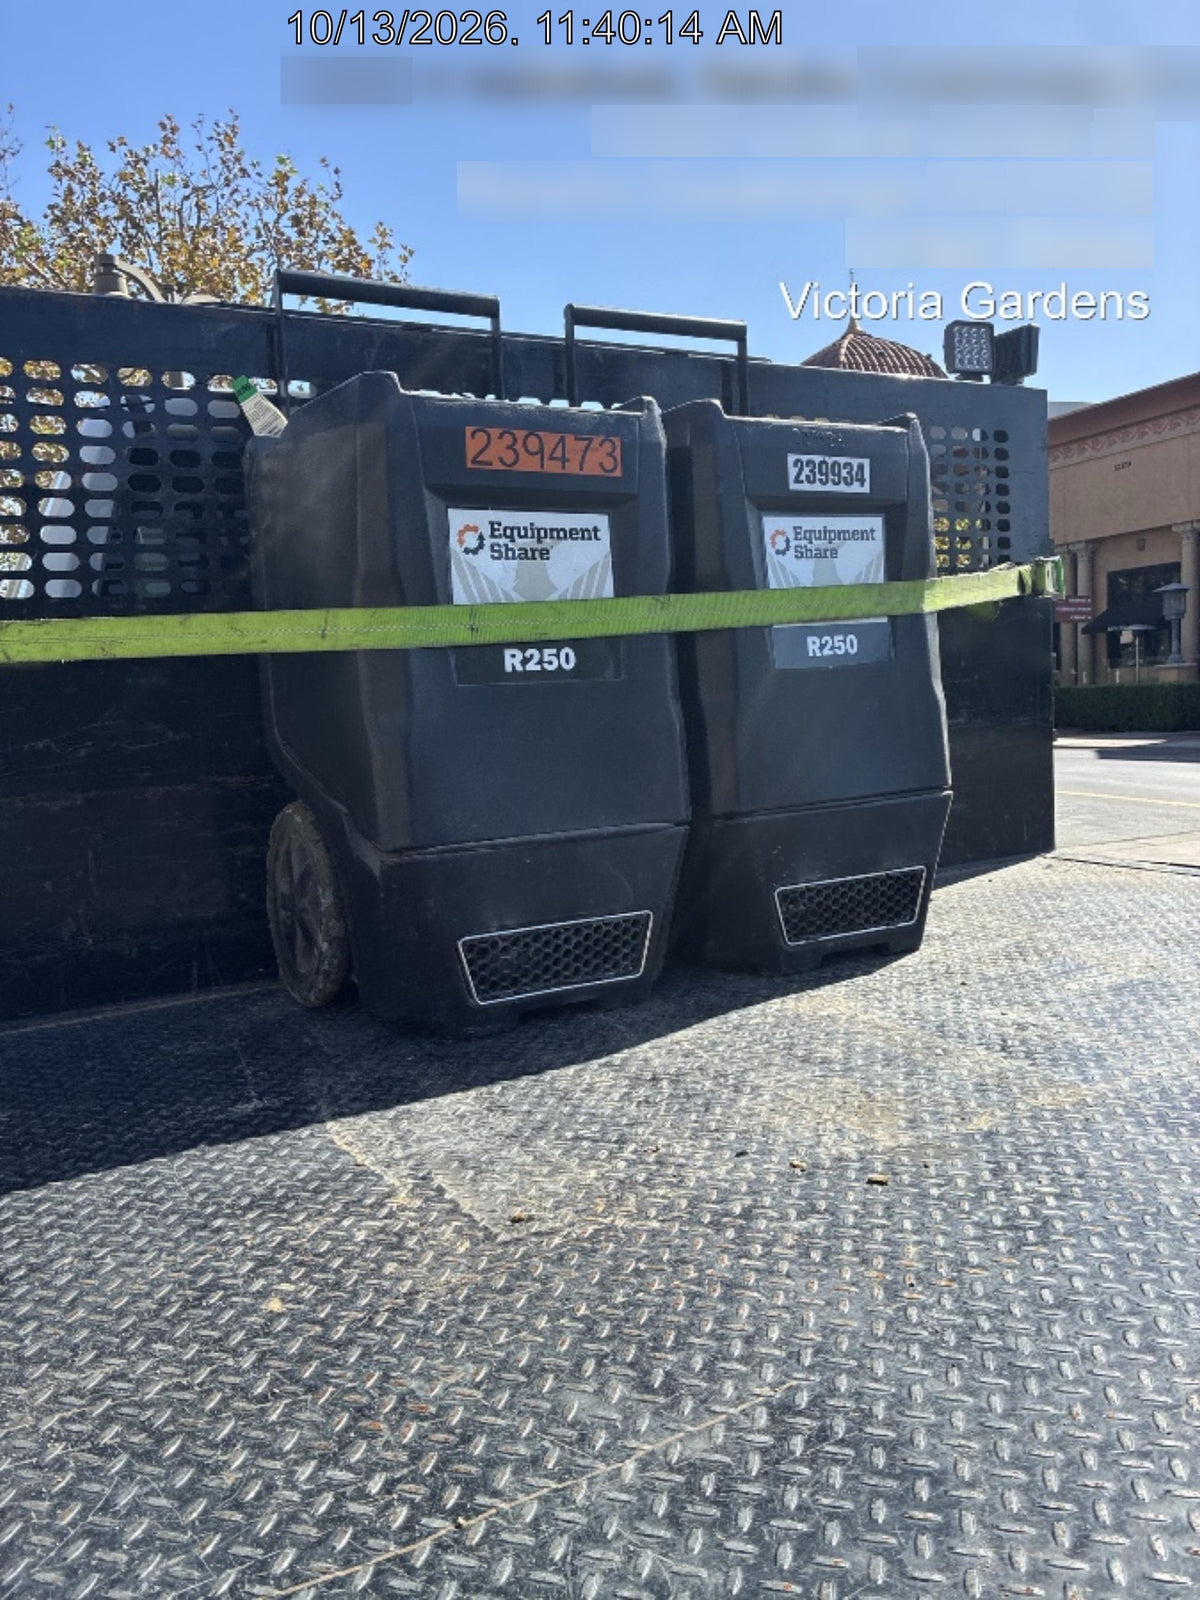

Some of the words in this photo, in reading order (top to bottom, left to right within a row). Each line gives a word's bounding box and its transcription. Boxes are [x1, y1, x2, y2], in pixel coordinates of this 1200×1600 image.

[470, 427, 619, 474] 239473
[792, 458, 867, 488] 239934
[489, 520, 601, 542] Equipment
[793, 526, 876, 545] Equipment
[490, 543, 550, 561] Share
[794, 545, 838, 560] Share
[806, 634, 858, 657] R250
[503, 645, 576, 673] R250
